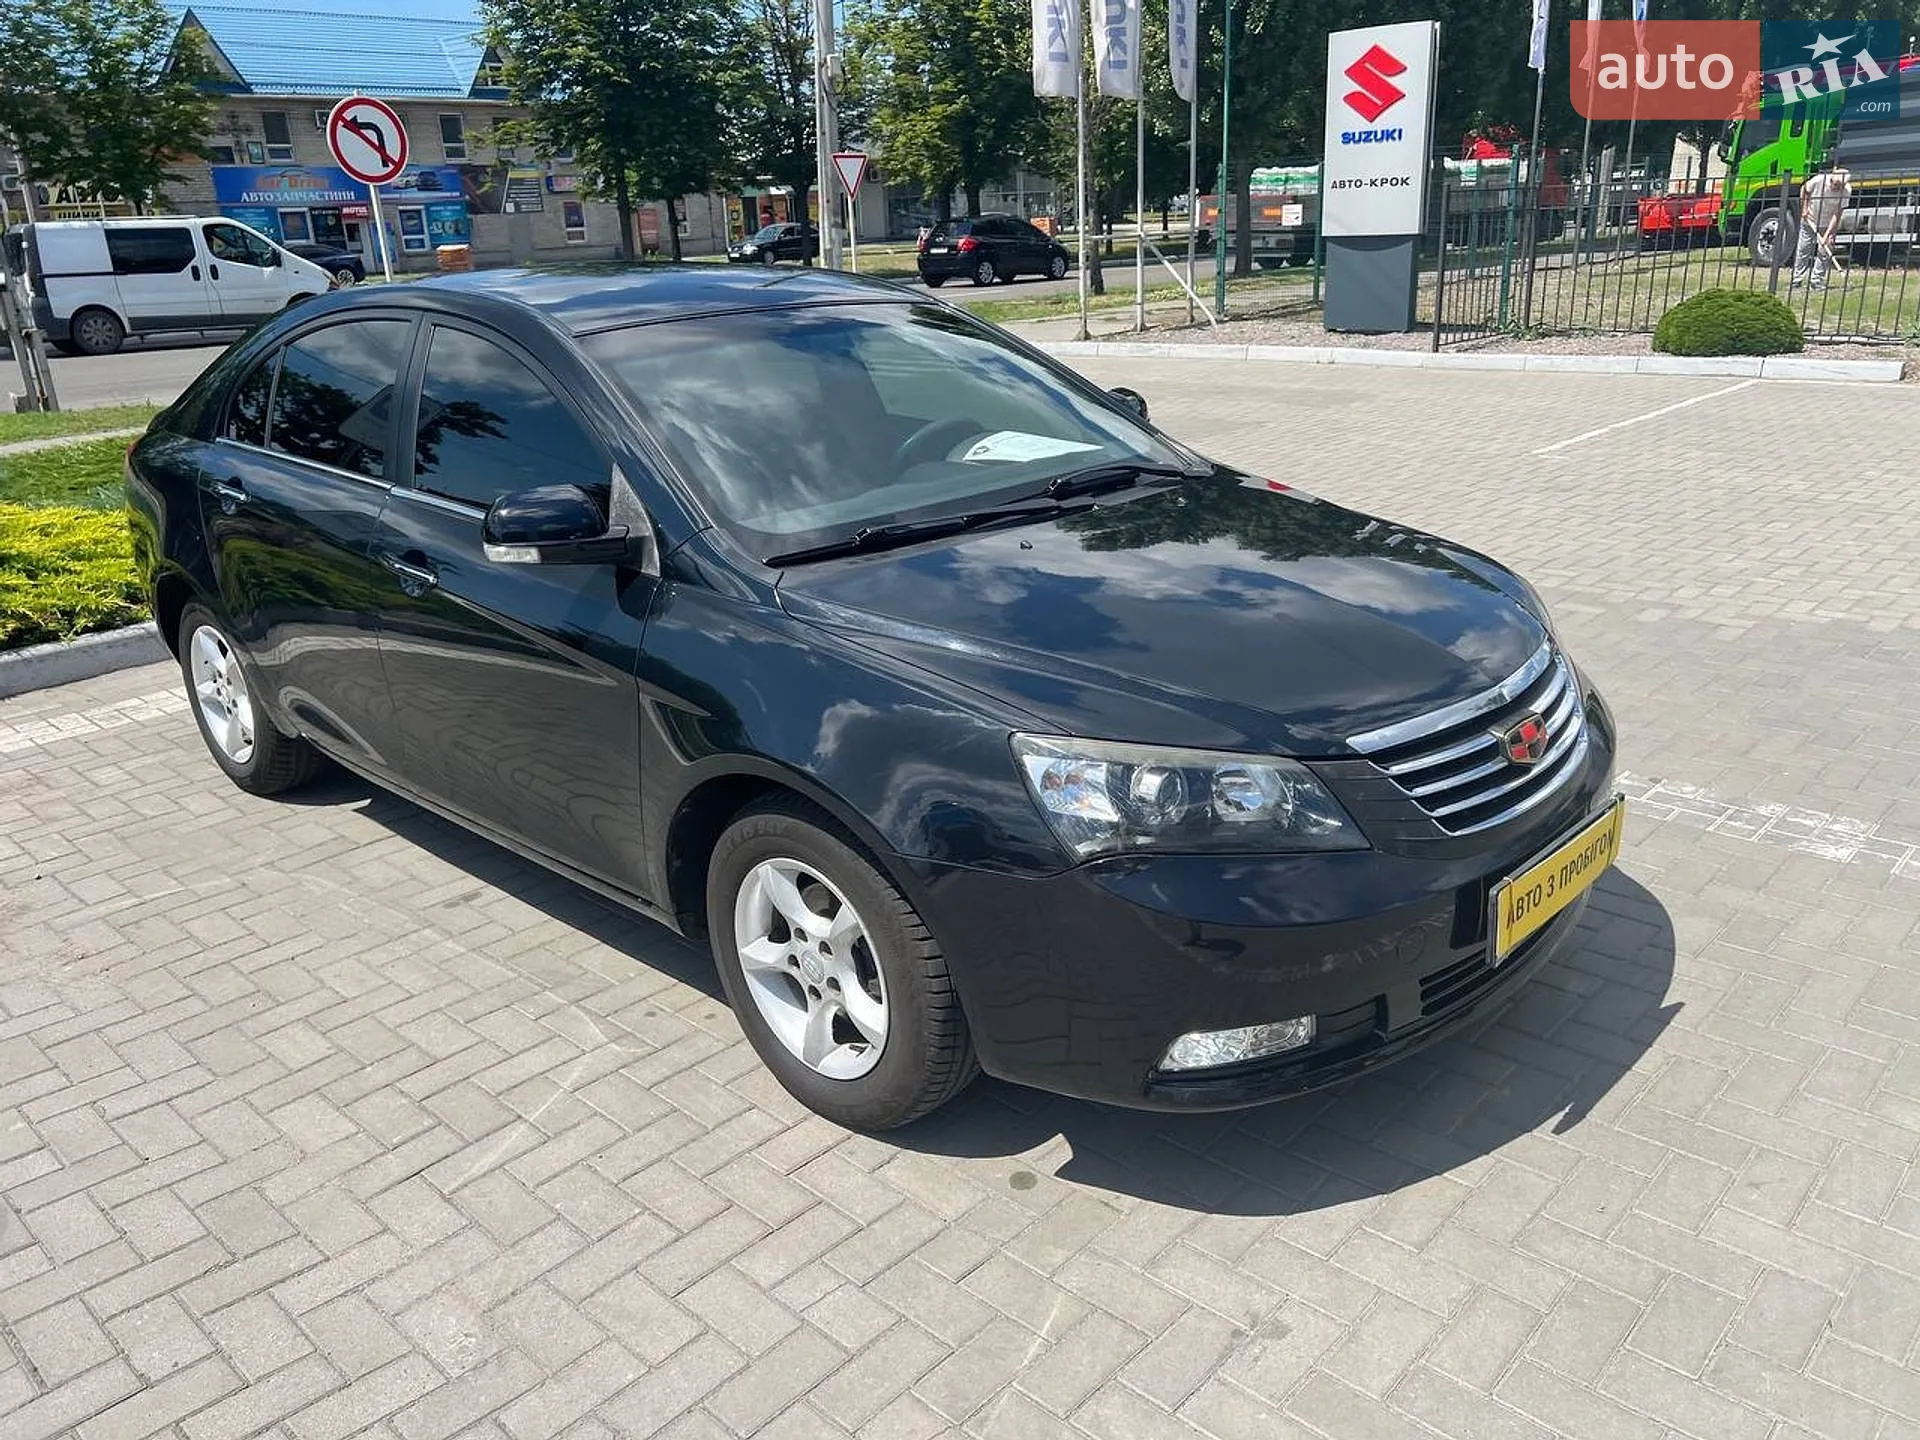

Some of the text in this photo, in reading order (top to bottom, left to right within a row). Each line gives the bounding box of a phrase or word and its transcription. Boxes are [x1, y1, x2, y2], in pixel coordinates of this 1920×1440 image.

[1340, 128, 1404, 145] SUZUKI
[1330, 177, 1411, 190] АВТО-КРОК
[240, 191, 356, 203] АВТОЗАПЧАСТИНИ
[1506, 883, 1542, 930] АВТО
